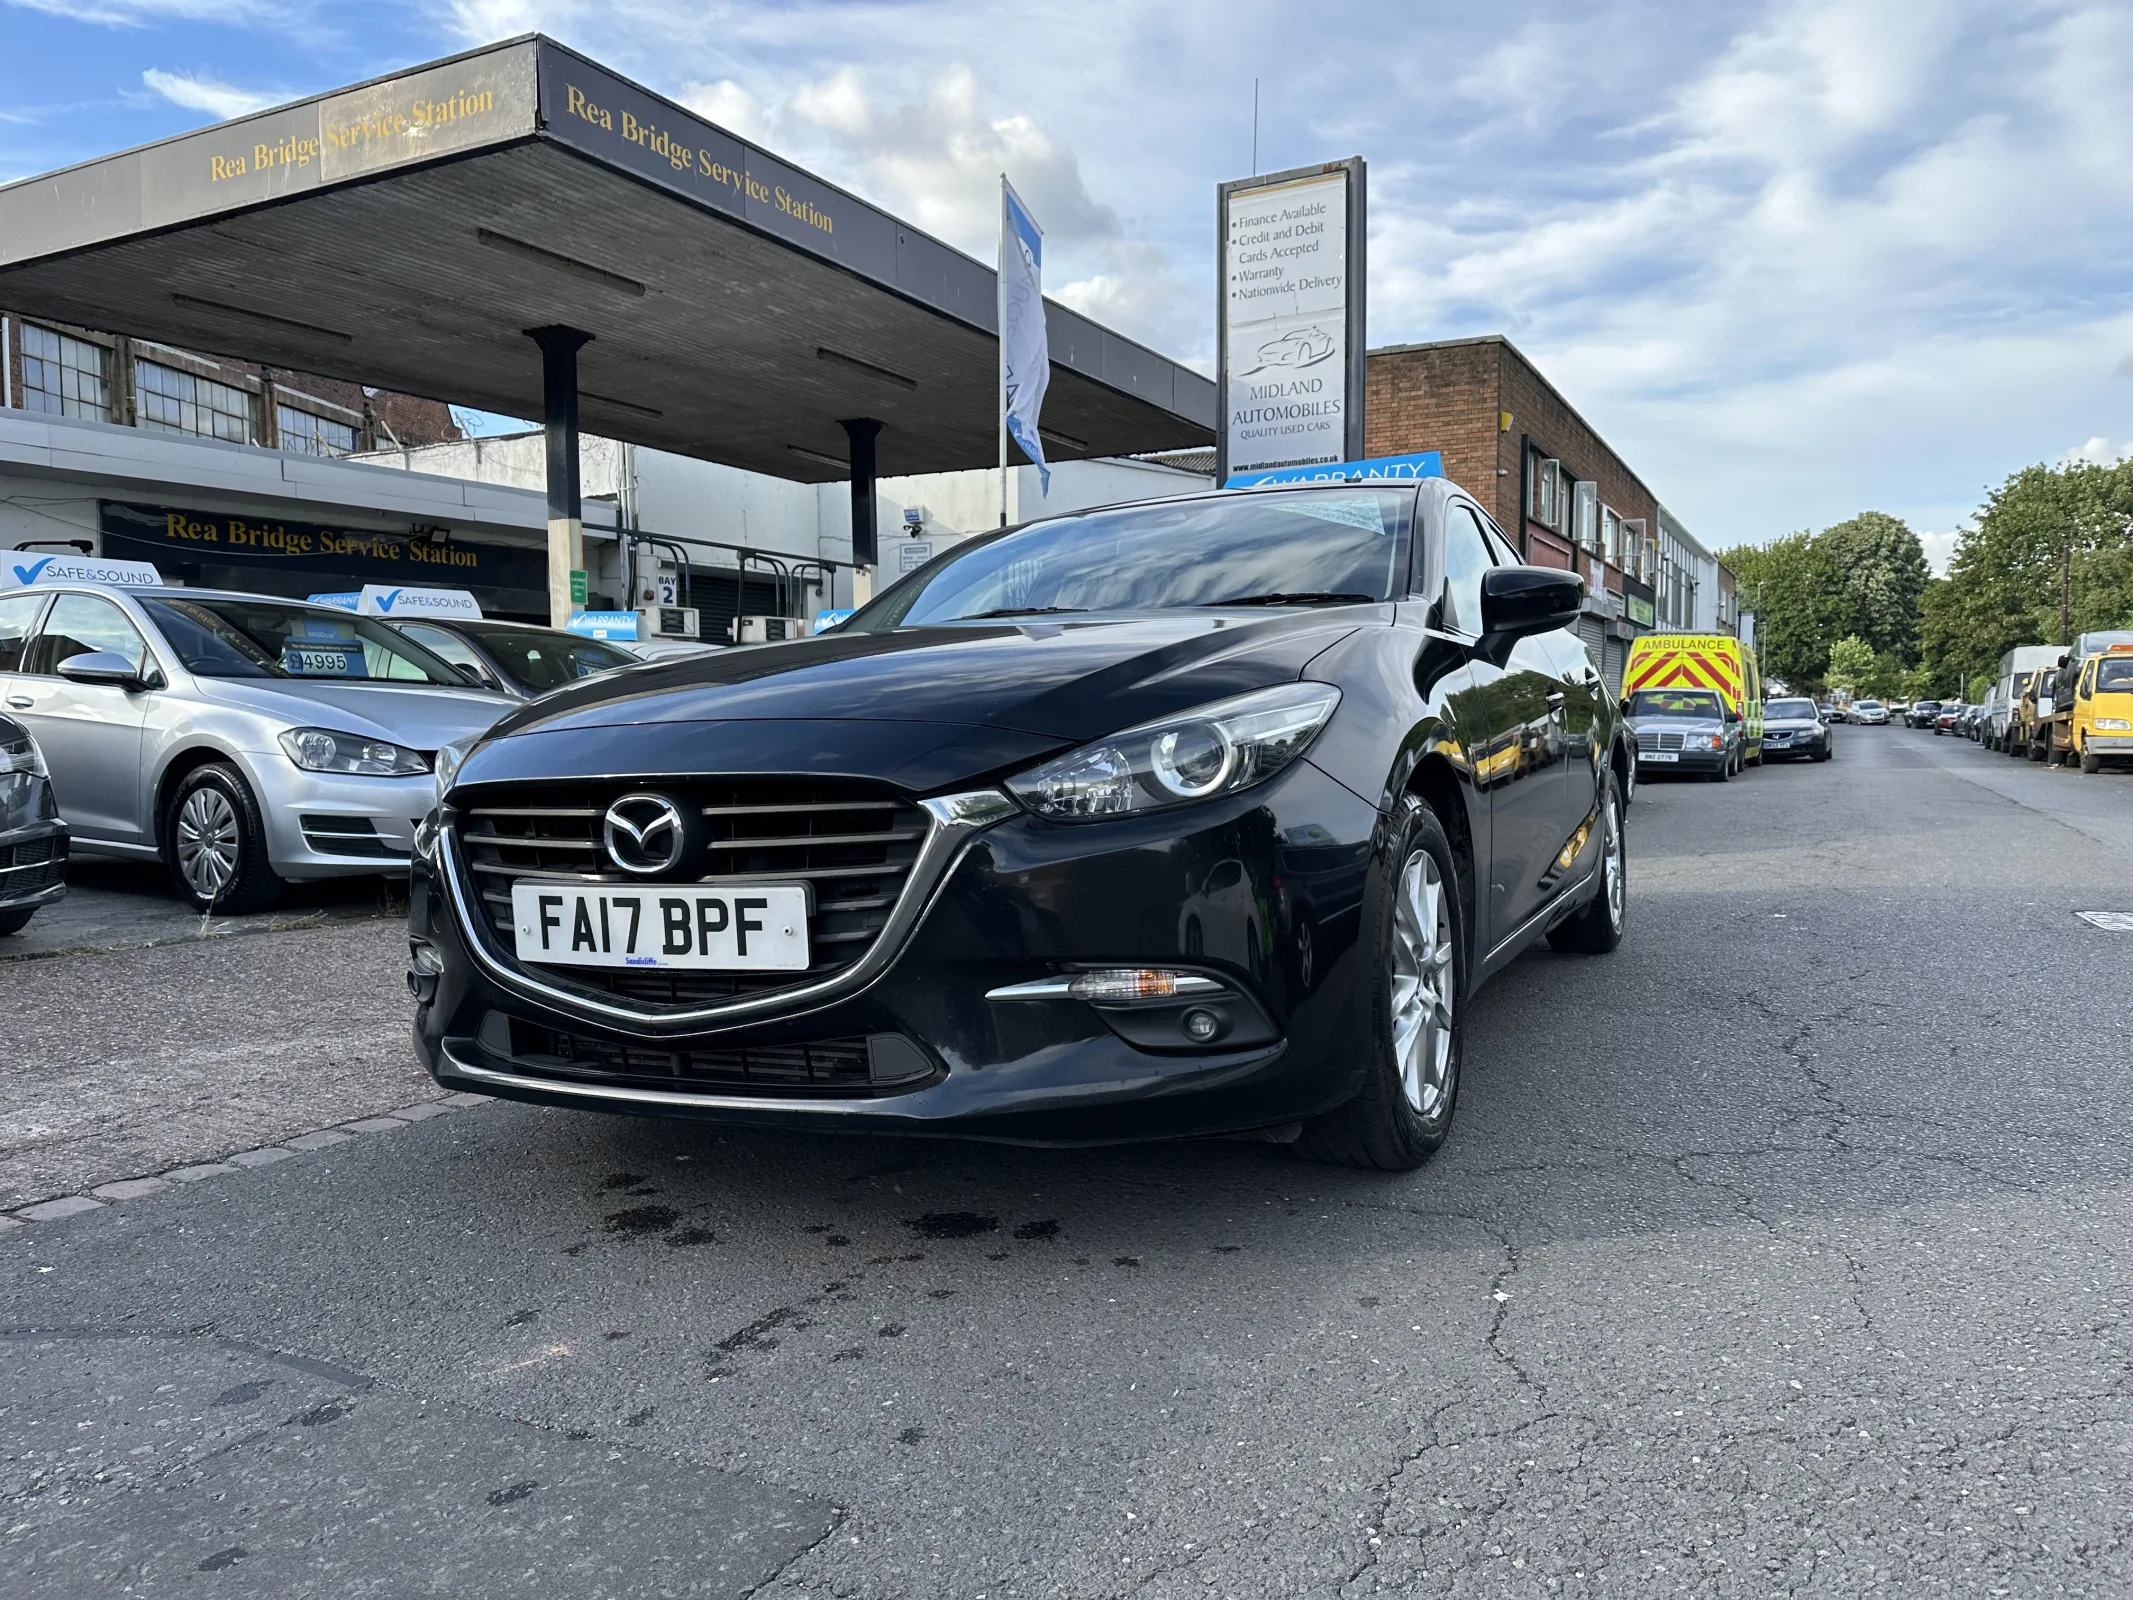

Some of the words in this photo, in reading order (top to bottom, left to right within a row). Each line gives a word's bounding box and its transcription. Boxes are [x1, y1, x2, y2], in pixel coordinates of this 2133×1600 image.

[210, 155, 246, 181] Rea
[254, 135, 319, 171] Bridge
[325, 112, 404, 150] Service
[412, 89, 493, 128] Station
[565, 83, 613, 131] Rea
[620, 110, 693, 171] Bridge
[699, 149, 769, 203] Service
[774, 185, 833, 234] Station
[1239, 213, 1277, 228] Finance
[1280, 202, 1326, 221] Available
[1239, 231, 1270, 246] Credit
[1273, 226, 1292, 240] and
[1295, 222, 1324, 236] Debit
[1239, 249, 1267, 263] Cards
[1270, 240, 1319, 259] Accepted
[1239, 266, 1284, 282] Warranty
[1239, 281, 1296, 300] Nationwide
[1299, 275, 1342, 290] Delivery
[1250, 378, 1323, 400] MIDLAND
[1232, 399, 1340, 425] AUTOMOBILES
[1240, 427, 1278, 440] QUALITY
[1280, 424, 1304, 435] USED
[1307, 421, 1331, 432] CARS
[1233, 454, 1338, 472] www.midlandautomobiles.co.uk
[164, 513, 217, 541] Rea
[228, 520, 312, 555] Bridge
[319, 530, 400, 560] Service
[409, 540, 477, 567] Station
[46, 566, 154, 584] SAFE&SOUND
[658, 576, 676, 586] BAY
[319, 595, 361, 605] WARRANT
[398, 595, 473, 609] SAFE&SOUND
[663, 587, 673, 604] 2
[584, 616, 632, 625] WARRANTY
[1642, 640, 1725, 650] AMBULANCE
[538, 895, 641, 953] FA17
[659, 898, 768, 956] BPF
[625, 957, 657, 966] Sandicliffe
